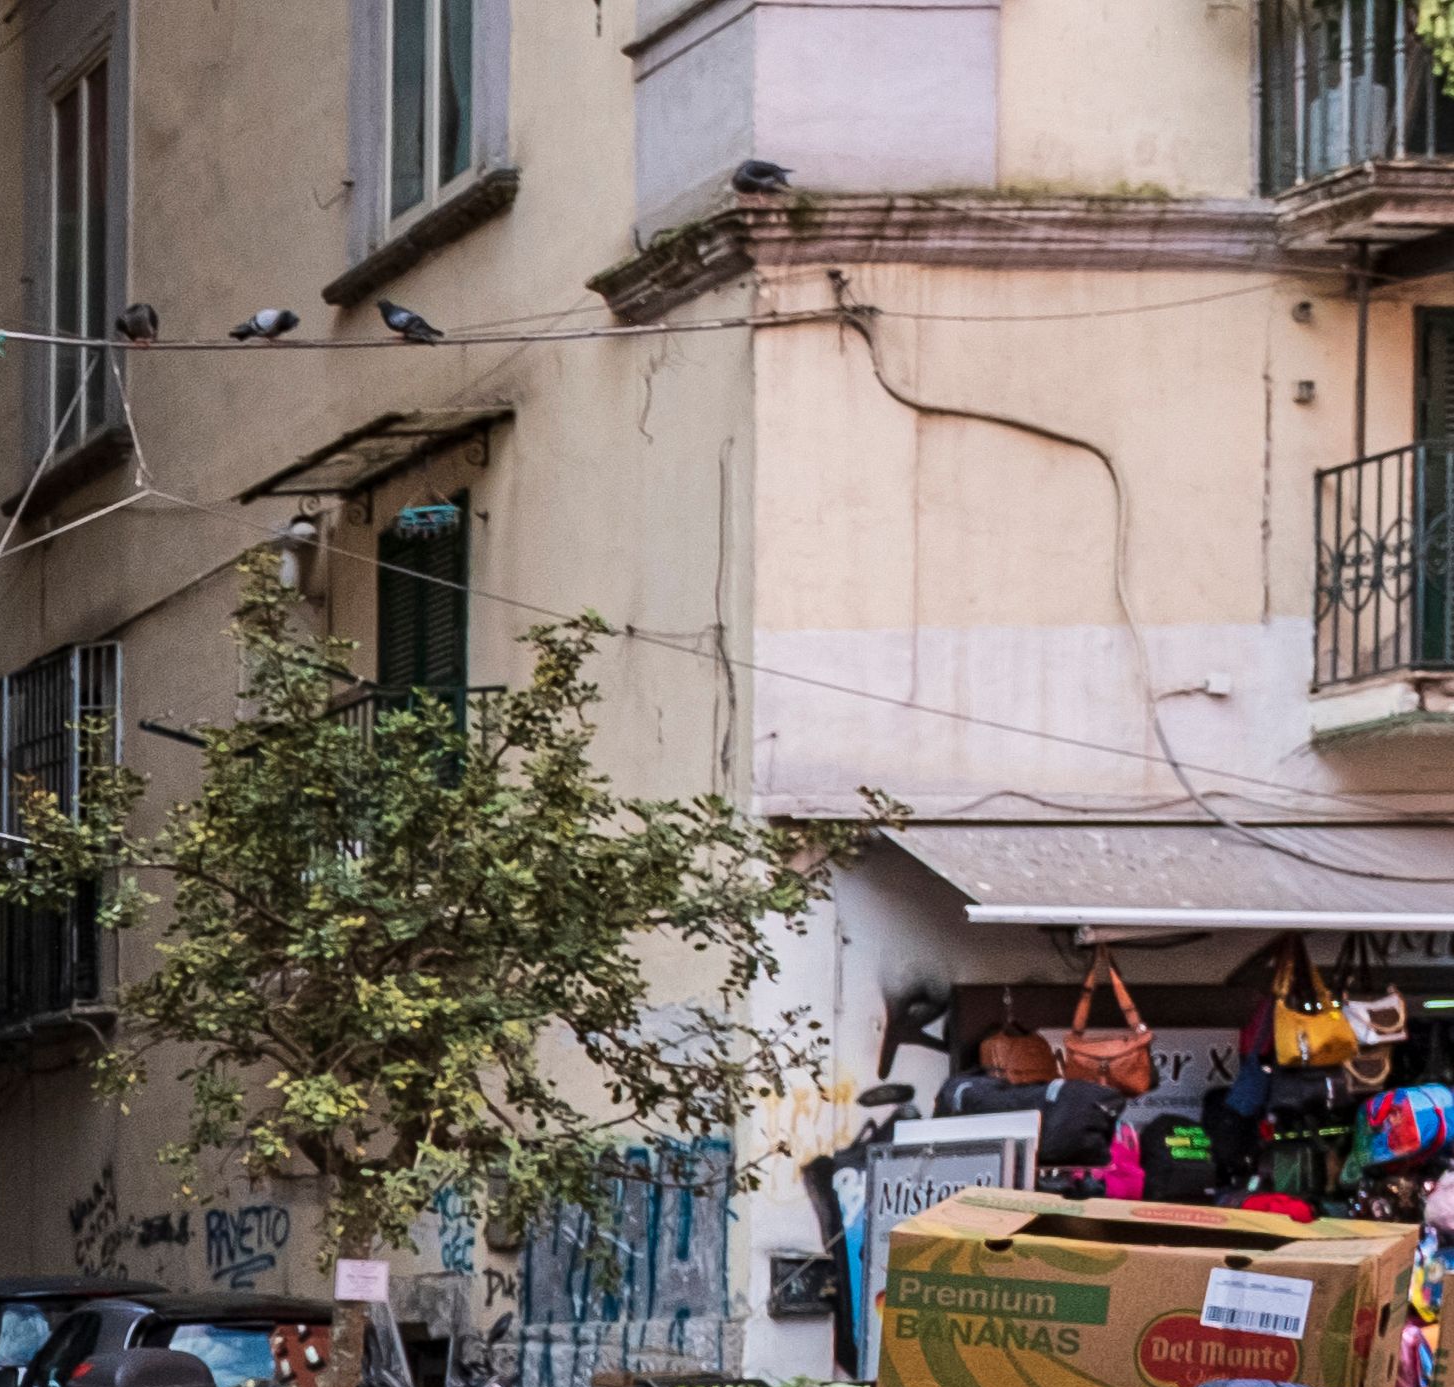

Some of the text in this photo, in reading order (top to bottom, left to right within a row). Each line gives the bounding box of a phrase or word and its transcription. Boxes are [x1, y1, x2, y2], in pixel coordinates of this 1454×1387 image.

[897, 1277, 1057, 1316] Premium
[894, 1310, 1081, 1355] BANANAS
[1151, 1335, 1290, 1372] Del Monte
